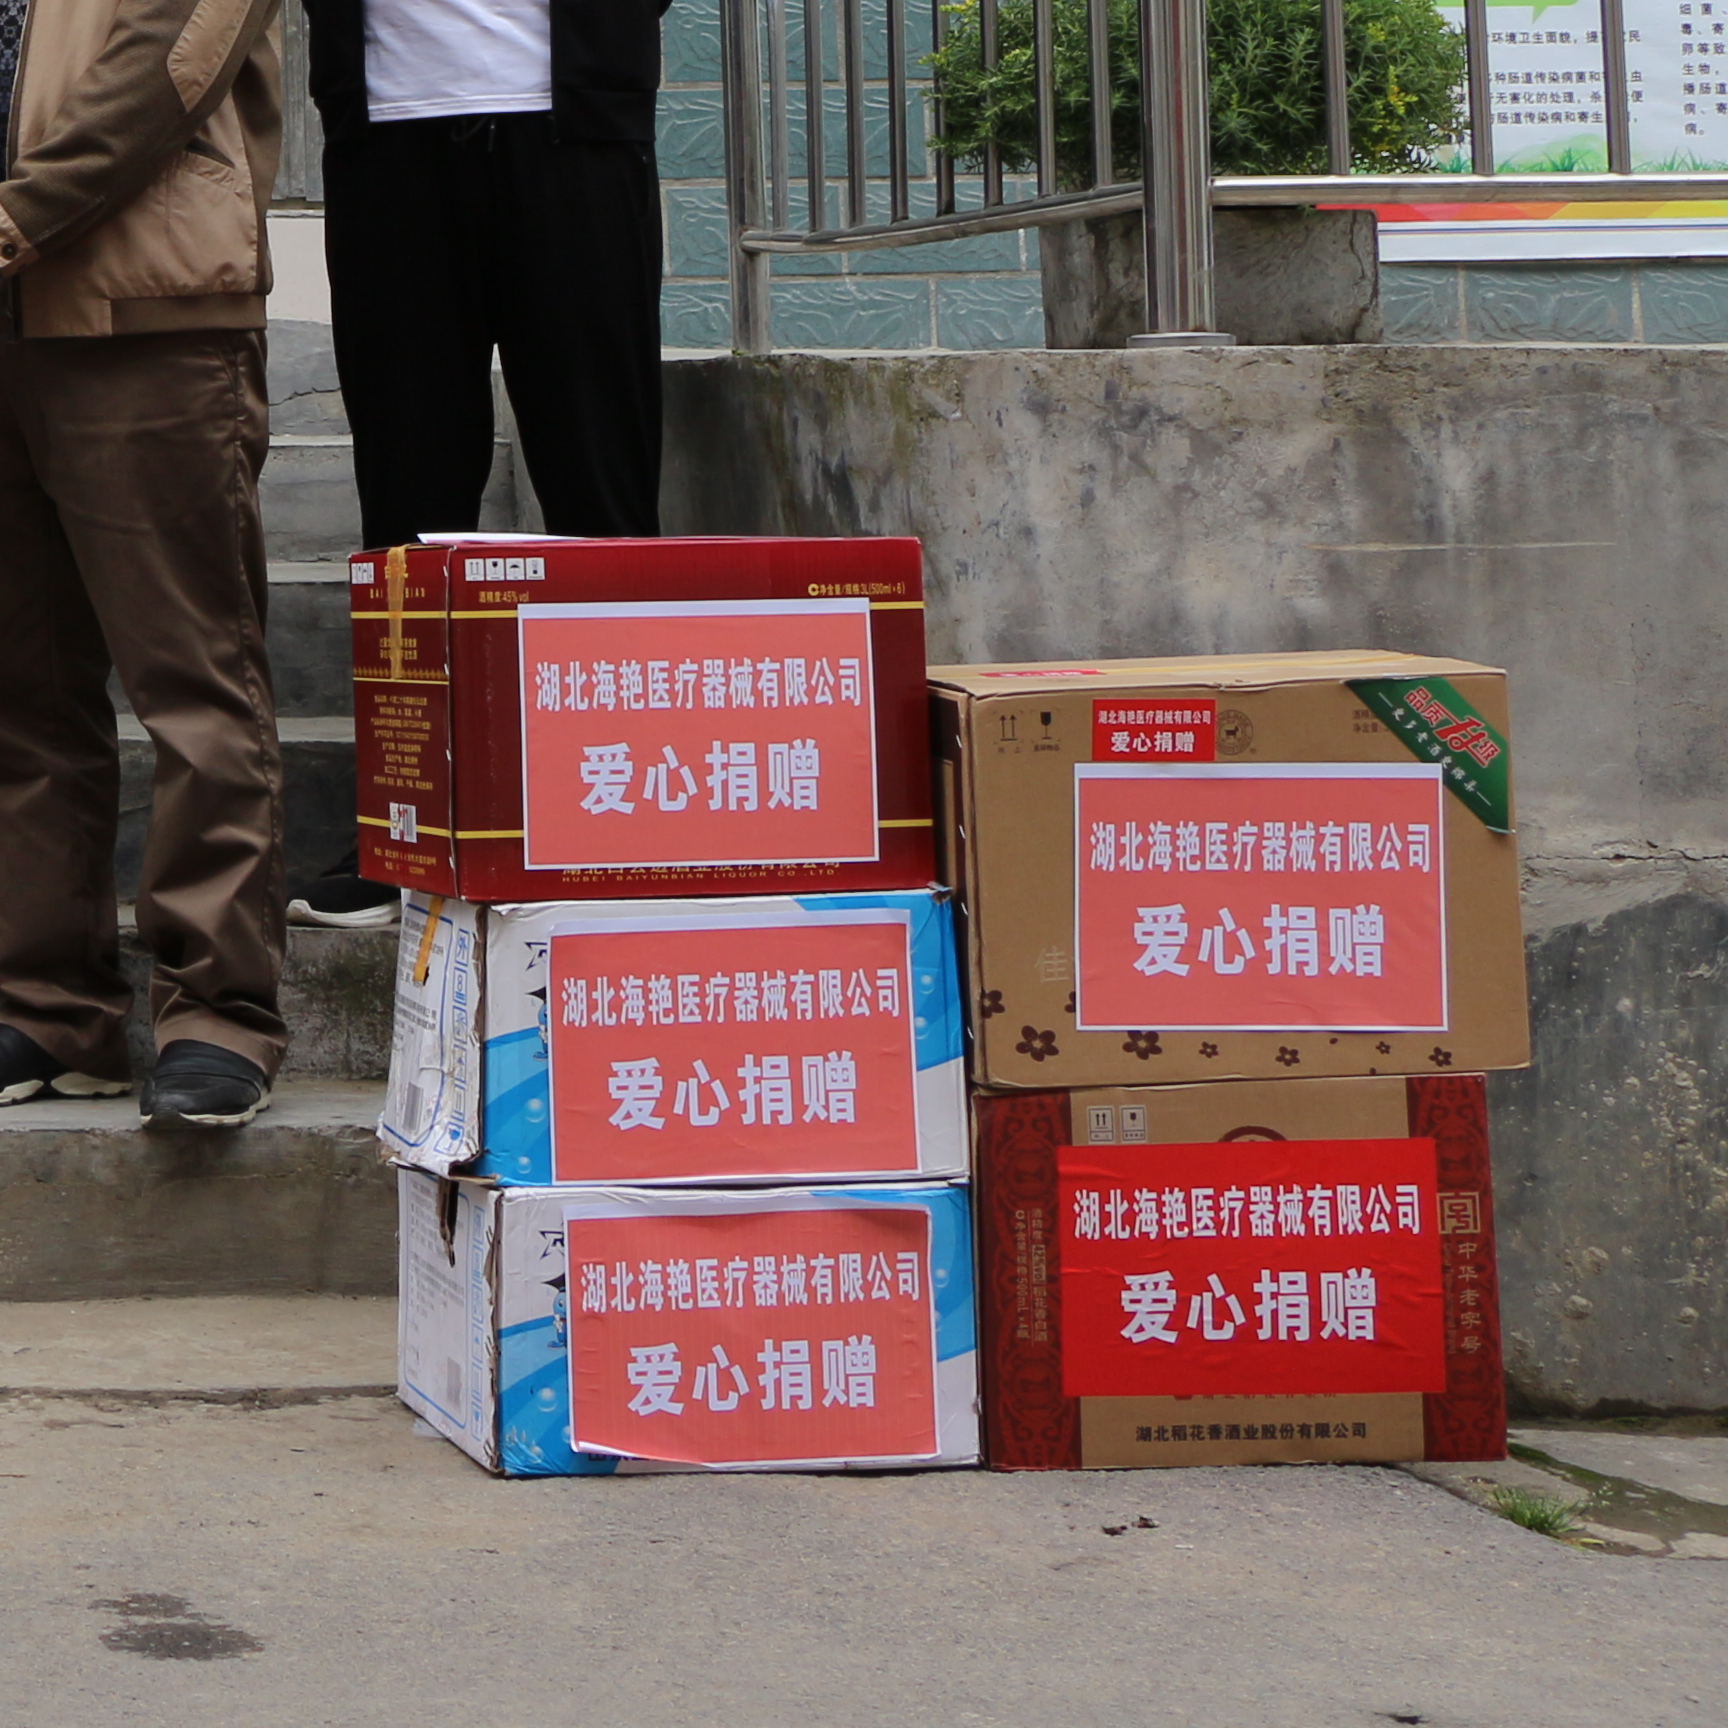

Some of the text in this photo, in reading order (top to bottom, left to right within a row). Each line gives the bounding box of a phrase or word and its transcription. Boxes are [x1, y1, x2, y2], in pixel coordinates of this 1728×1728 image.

[534, 655, 863, 712] 湖北海艳医疗器械有限公司
[1098, 710, 1211, 725] 湖北海艳医疗器械有限公司
[1111, 731, 1195, 753] 爱心捐赠
[579, 738, 823, 816] 爱心捐赠
[562, 875, 606, 883] HUBEI
[616, 873, 705, 881] BAIYUNBIAN
[713, 871, 768, 879] LIQUOR
[1089, 820, 1432, 875] 湖北海艳医疗器械有限公司
[1131, 903, 1386, 980] 爱心捐赠
[560, 966, 902, 1030] 湖北海艳医疗器械有限公司
[607, 1050, 859, 1132] 爱心捐赠
[1073, 1183, 1421, 1241] 湖北海艳医疗器械有限公司
[581, 1250, 922, 1314] 湖北海艳医疗器械有限公司
[1120, 1266, 1377, 1345] 爱心捐赠
[1457, 1241, 1482, 1354] 中华老字号
[625, 1333, 879, 1418] 爱心捐赠
[1135, 1421, 1367, 1443] 湖北稻花香酒业股份有限公司
